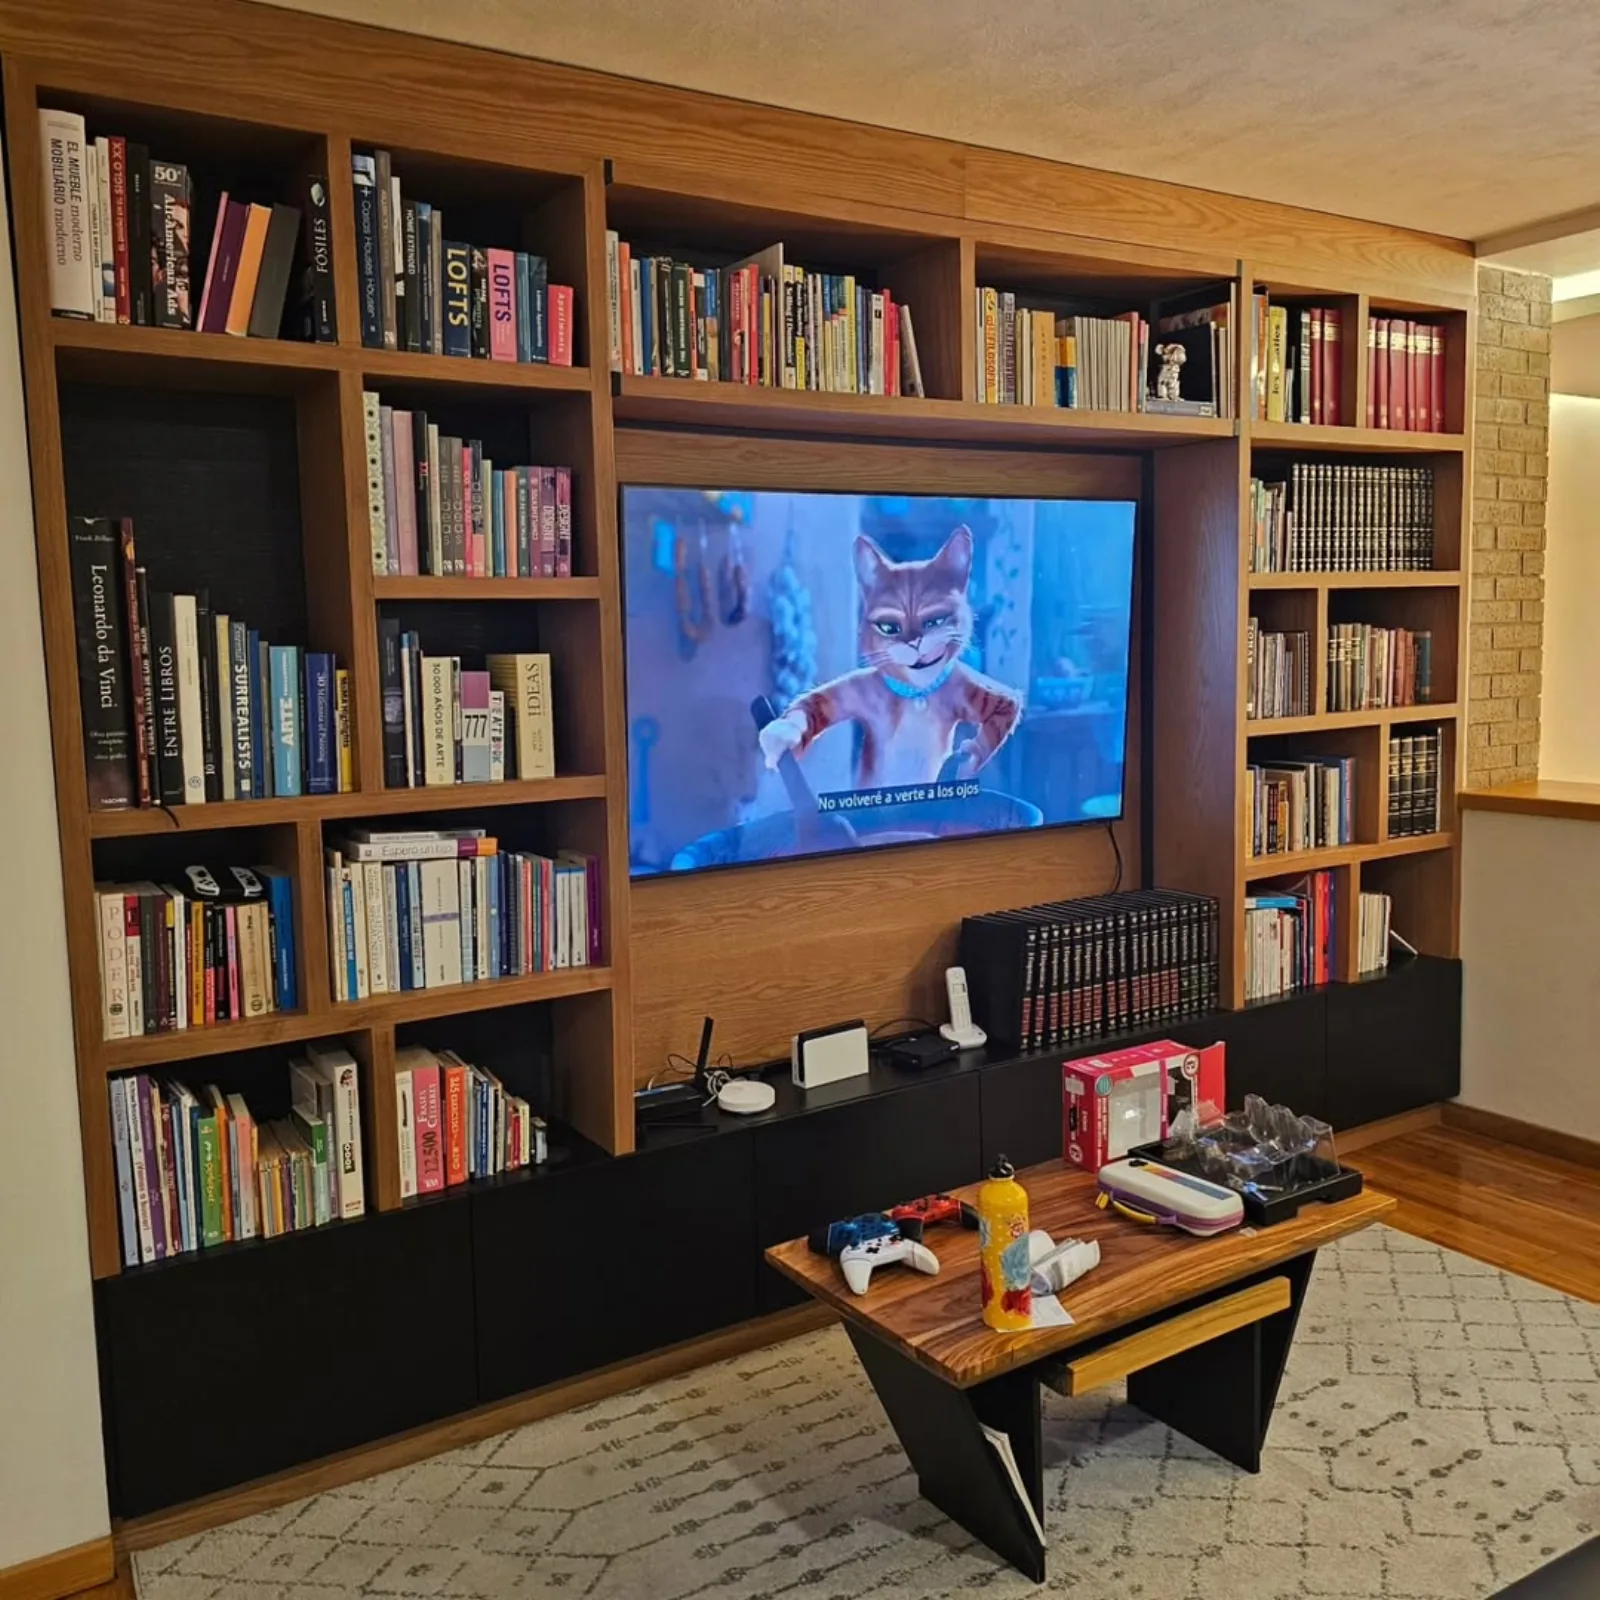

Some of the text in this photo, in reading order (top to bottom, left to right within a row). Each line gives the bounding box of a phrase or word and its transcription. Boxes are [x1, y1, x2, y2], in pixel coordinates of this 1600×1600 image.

[112, 141, 121, 161] XX
[50, 138, 67, 266] MOBILIÁRIO moderno
[66, 140, 83, 262] EL MUEBLE moderno
[114, 161, 123, 195] SIGLO
[362, 200, 372, 235] Casas
[406, 209, 416, 275] HOME EXTENDED
[163, 193, 179, 316] All-American Ads
[363, 236, 374, 277] Houses
[446, 248, 469, 327] LOFTS
[492, 263, 512, 322] LOFTS
[90, 564, 118, 709] Leonardo da Vinci
[159, 645, 178, 758] ENTRE LIBROS
[316, 672, 327, 687] 30
[525, 662, 542, 717] IDEAS
[233, 664, 252, 770] SURREALISTS
[281, 697, 295, 746] ARTE
[433, 697, 443, 726] AÑOS
[436, 727, 444, 740] DE
[464, 714, 488, 739] 777
[436, 742, 445, 768] ARTE
[818, 796, 835, 811] No
[838, 791, 883, 808] volveré
[895, 790, 925, 803] verte
[927, 789, 935, 799] a
[937, 785, 954, 798] los
[956, 784, 979, 799] ojos
